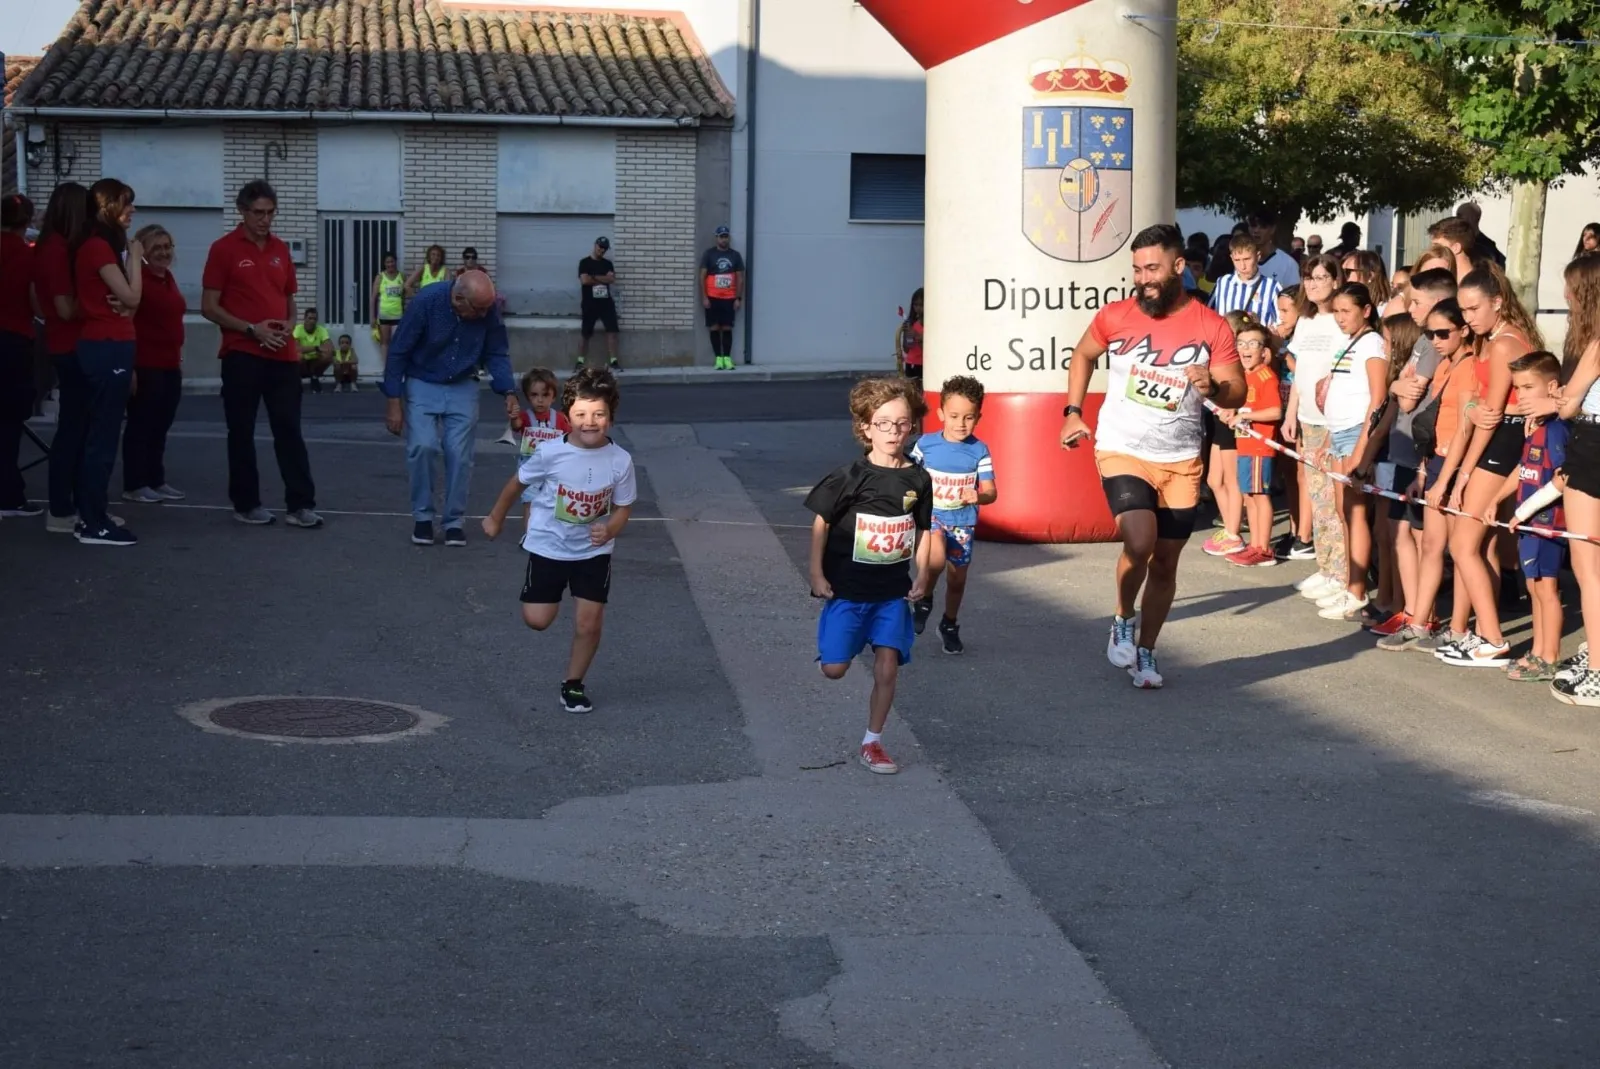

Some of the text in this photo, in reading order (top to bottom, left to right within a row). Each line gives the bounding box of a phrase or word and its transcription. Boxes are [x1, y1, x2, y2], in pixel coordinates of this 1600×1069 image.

[966, 345, 992, 371] de
[1136, 380, 1171, 402] 264
[932, 475, 975, 487] edunia
[1519, 465, 1539, 480] ten
[566, 501, 602, 518] 439
[867, 533, 905, 553] 434
